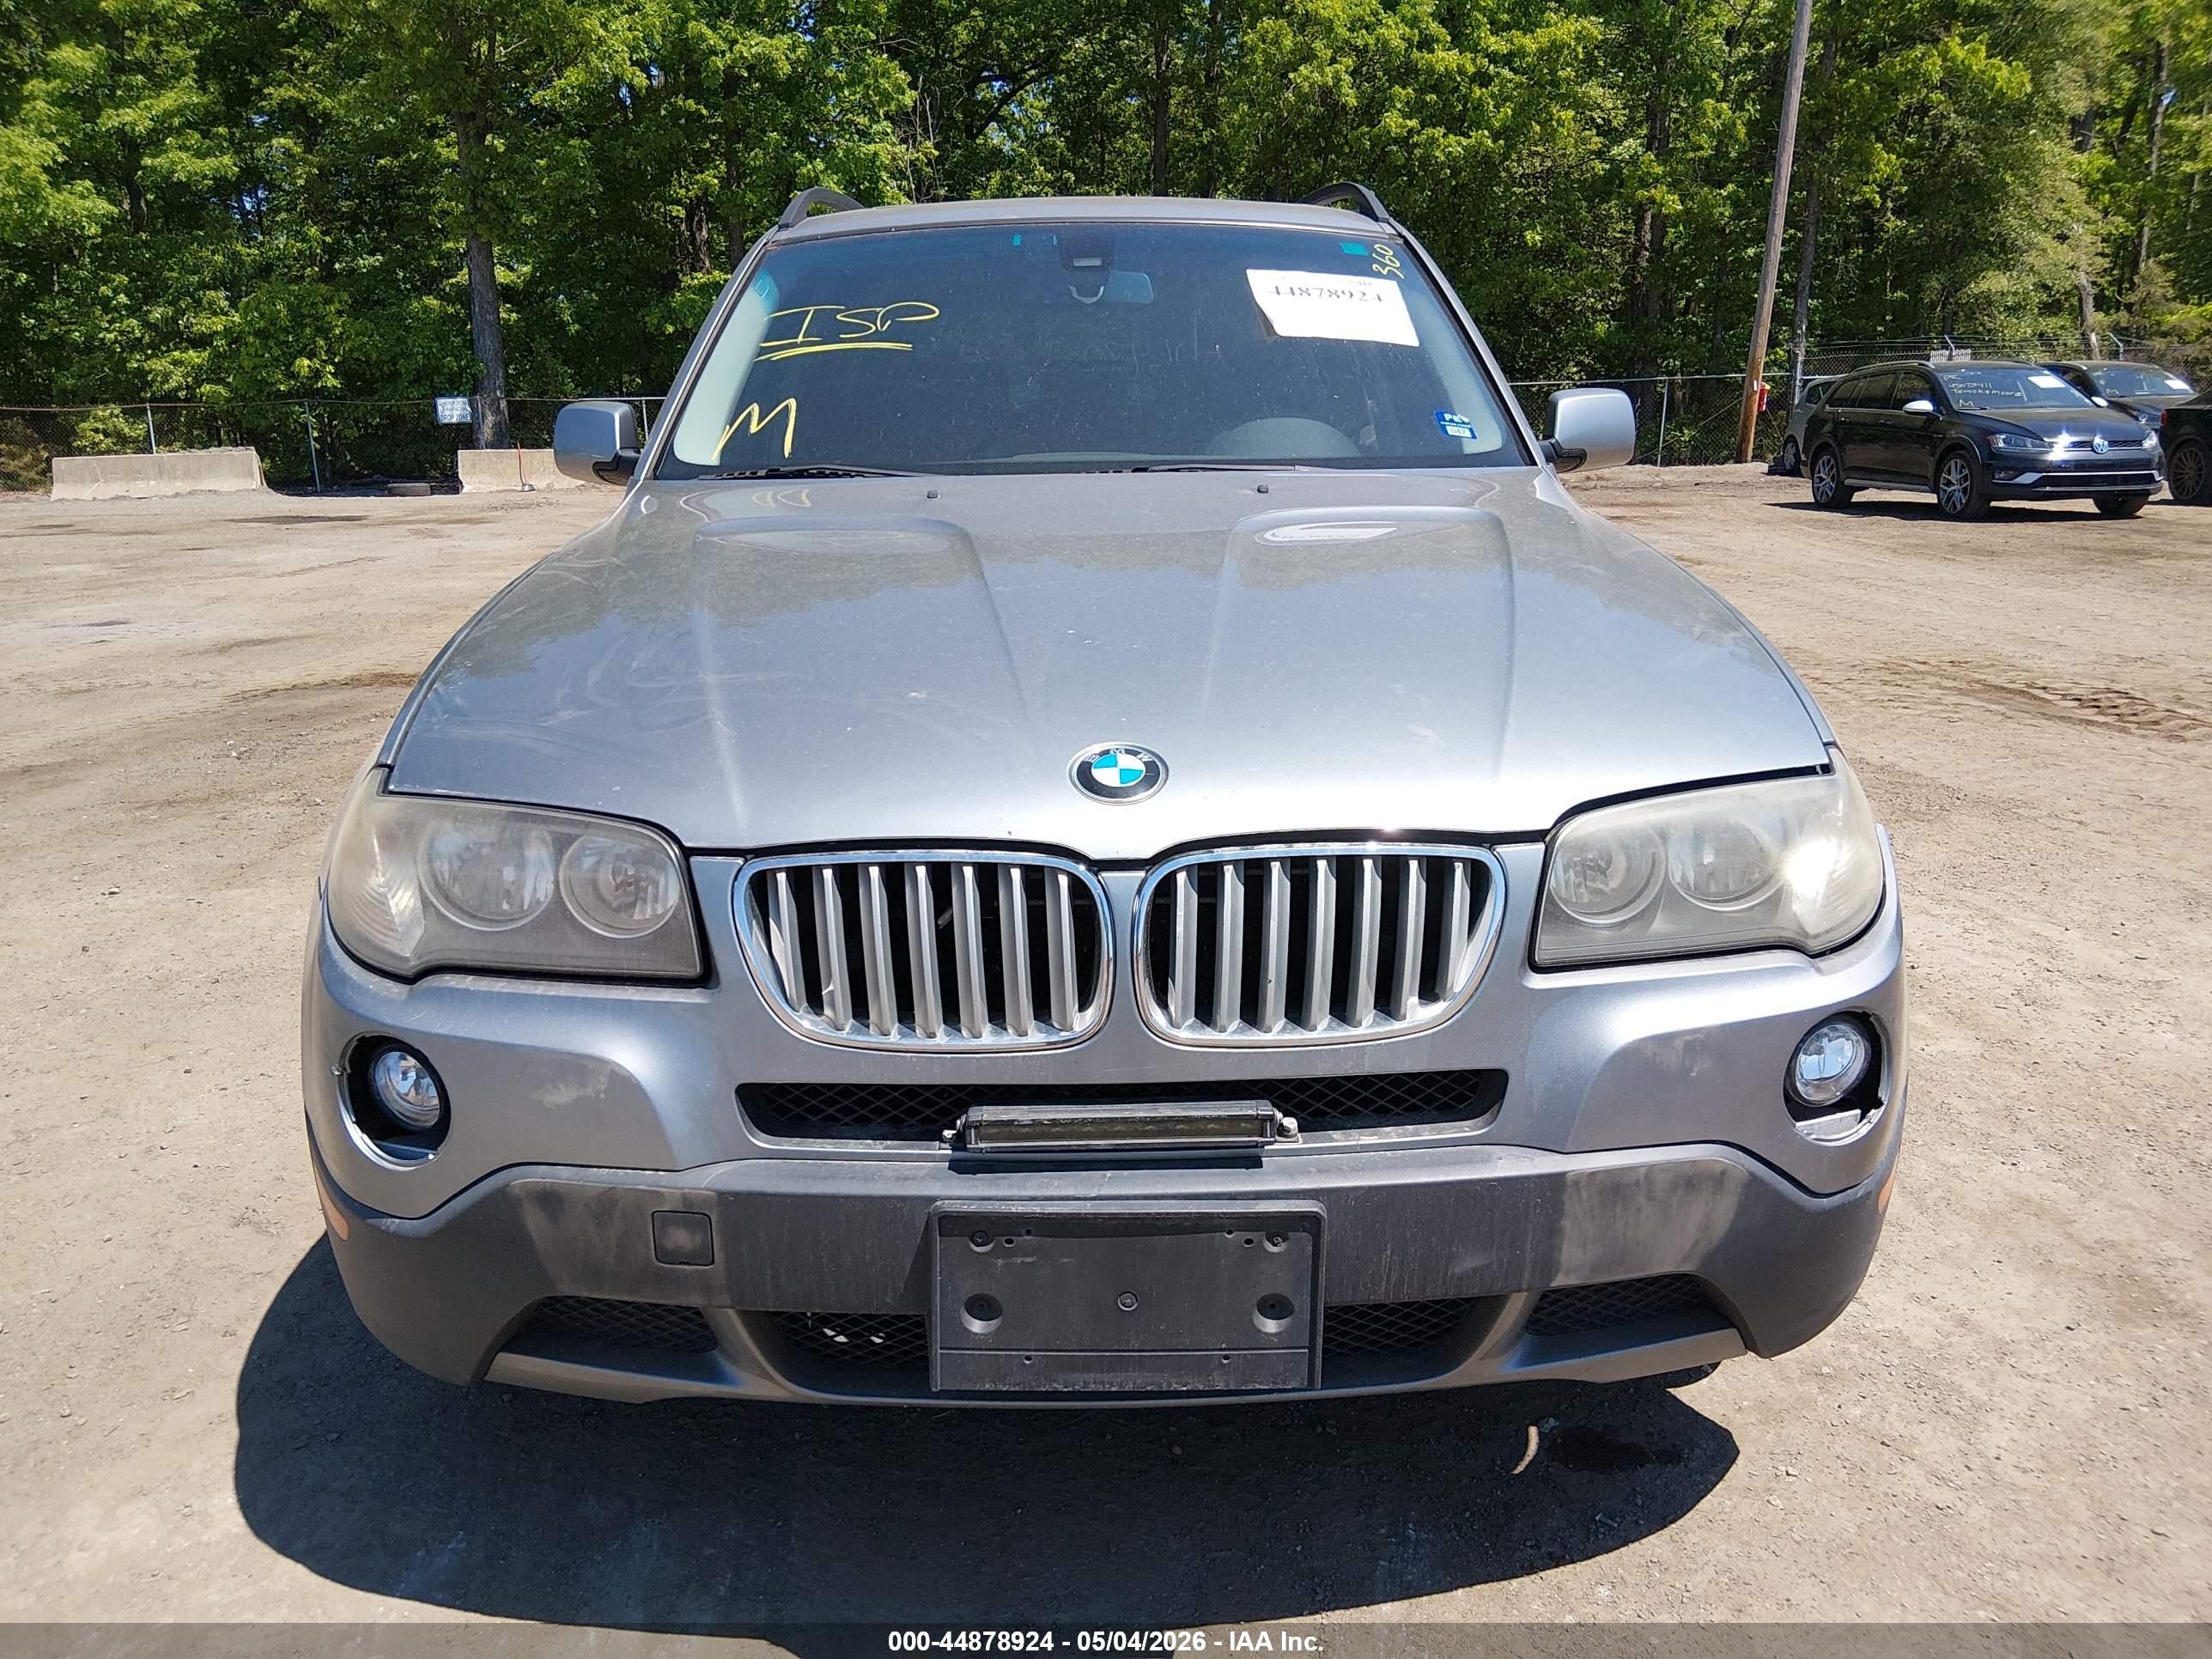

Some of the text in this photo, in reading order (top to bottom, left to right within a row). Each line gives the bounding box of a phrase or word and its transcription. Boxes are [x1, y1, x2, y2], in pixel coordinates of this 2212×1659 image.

[1372, 243, 1406, 280] 360
[1959, 398, 1975, 407] M
[455, 412, 471, 421] ZONE
[711, 397, 798, 460] M
[1084, 747, 1154, 763] BMW
